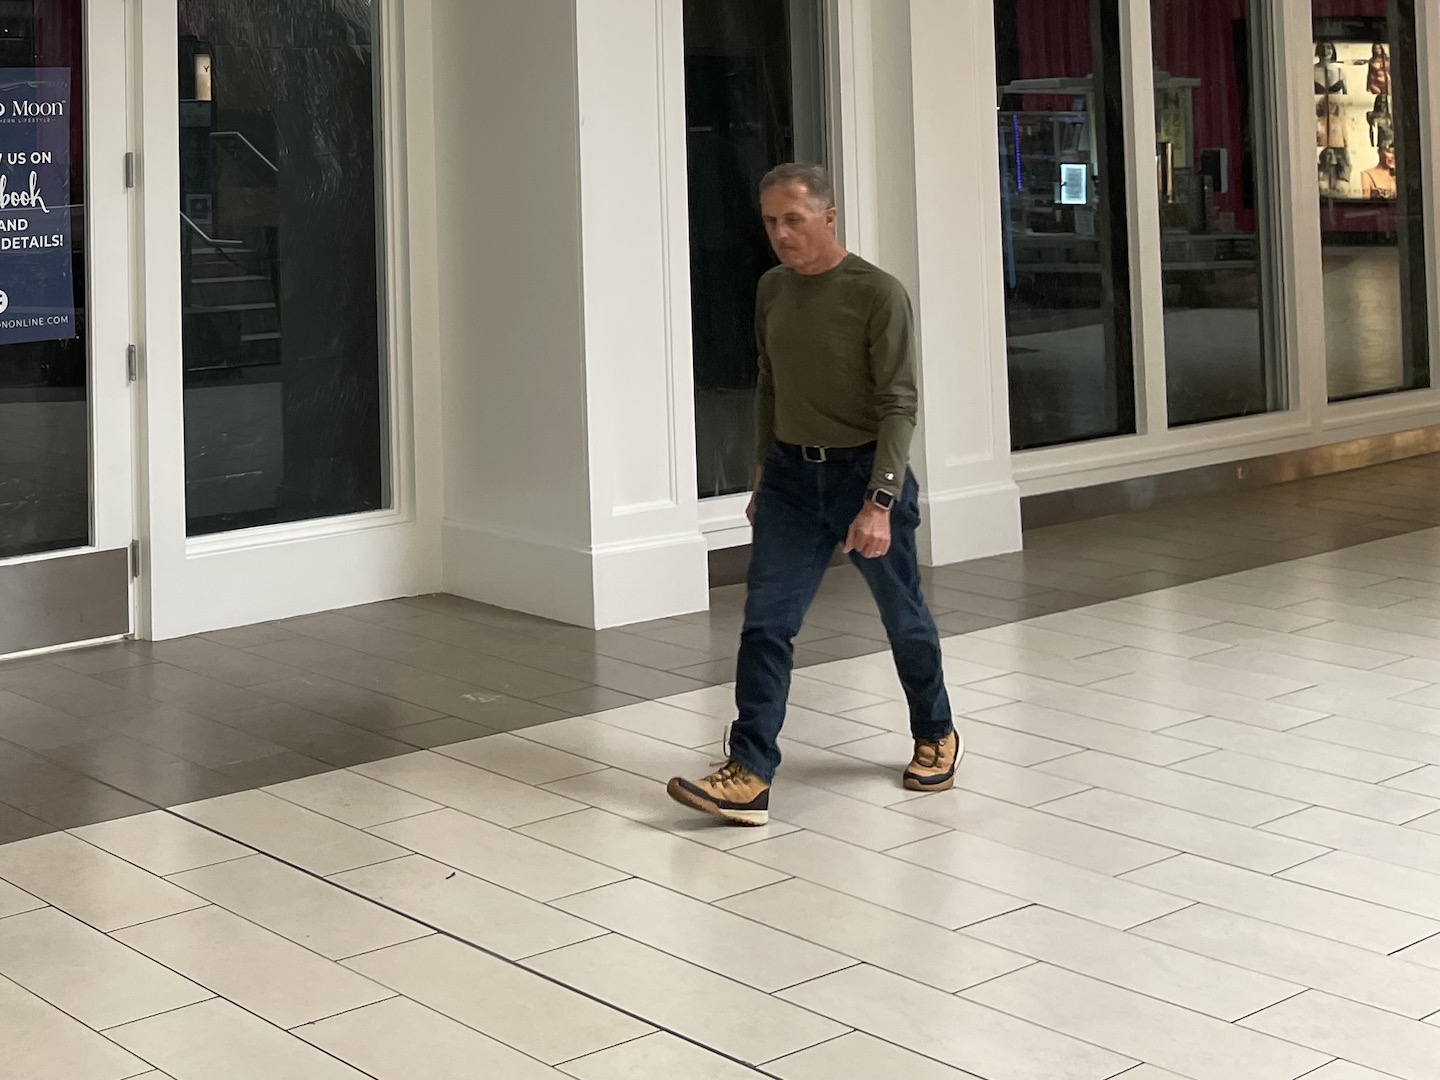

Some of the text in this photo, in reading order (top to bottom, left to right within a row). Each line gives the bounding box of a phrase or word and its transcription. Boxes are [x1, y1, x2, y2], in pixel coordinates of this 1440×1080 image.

[7, 152, 27, 165] US
[30, 151, 52, 164] ON
[1, 234, 64, 250] DETAILS!
